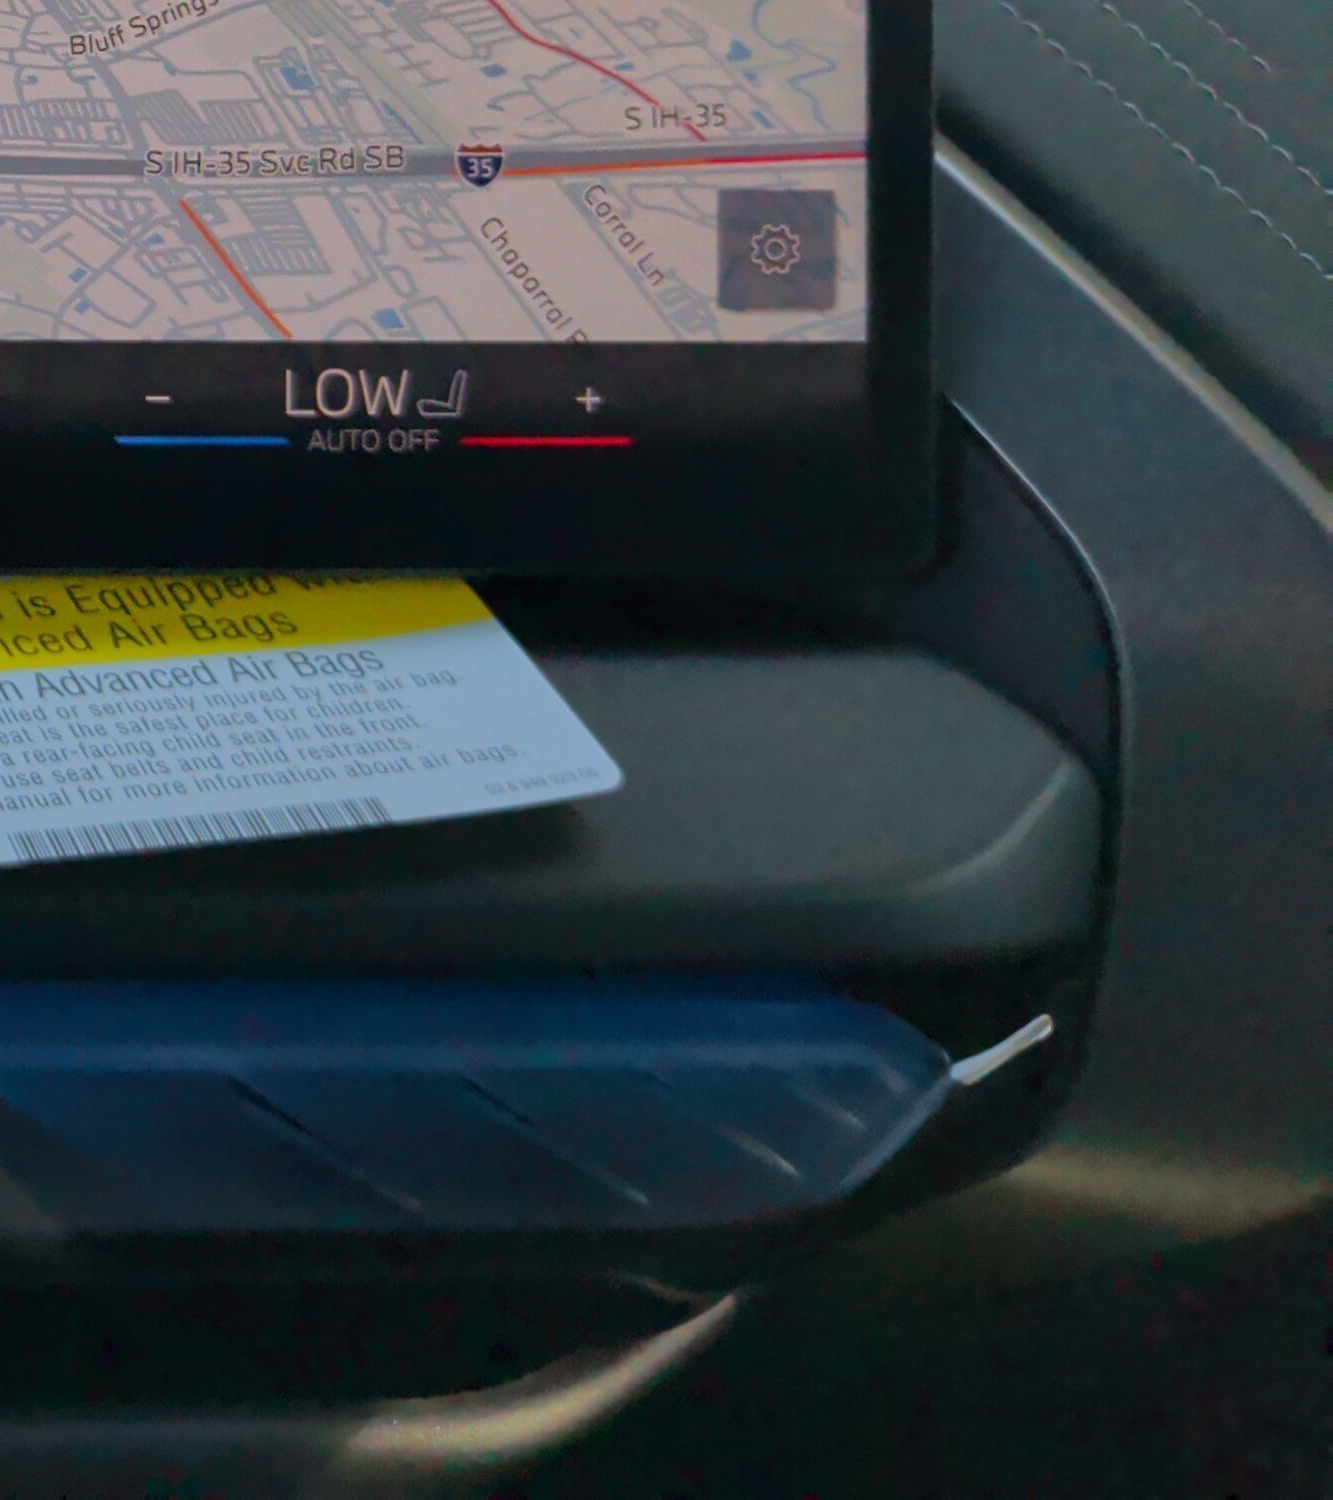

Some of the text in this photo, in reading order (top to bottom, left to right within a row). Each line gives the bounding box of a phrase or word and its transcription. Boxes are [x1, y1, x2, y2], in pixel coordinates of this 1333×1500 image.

[69, 24, 126, 56] Bluff
[624, 103, 728, 132] S IH-35
[145, 144, 405, 176] S IH-35 Svc Rd SB
[466, 156, 493, 179] 35
[585, 184, 665, 287] Corral Ln
[480, 216, 574, 331] Chaparral
[284, 368, 410, 419] LOW
[308, 428, 441, 454] AUTO OFF
[14, 590, 57, 620] is
[64, 572, 279, 617] Equipped
[106, 619, 169, 650] Air
[180, 609, 300, 643] Bags
[31, 660, 218, 700] Advanced
[230, 654, 279, 684] Air
[285, 647, 385, 679] Bags
[55, 702, 80, 720] or
[88, 692, 196, 717] seriously
[204, 686, 288, 709] injured
[290, 683, 323, 702] by
[327, 677, 366, 697] the
[375, 674, 405, 693] air
[410, 667, 467, 688] bag.
[0, 751, 17, 767] a
[23, 738, 156, 767] rear-facing
[162, 730, 221, 752] child
[229, 726, 281, 747] seat
[286, 722, 310, 741] in
[314, 719, 354, 739] the
[358, 712, 428, 734] front.
[40, 723, 63, 742] is
[70, 719, 109, 739] the
[115, 713, 190, 736] safest
[195, 708, 258, 731] place
[263, 703, 298, 723] for
[306, 695, 412, 721] children.
[1, 769, 45, 789] use
[51, 763, 105, 786] seat
[110, 755, 172, 780] belts
[181, 751, 224, 773] and
[230, 745, 291, 769] child
[296, 736, 422, 764] restraints.
[77, 782, 114, 803] for
[122, 777, 188, 801] more
[192, 763, 338, 794] information
[345, 754, 416, 779] about
[421, 749, 452, 770] air
[459, 741, 526, 765] bags.
